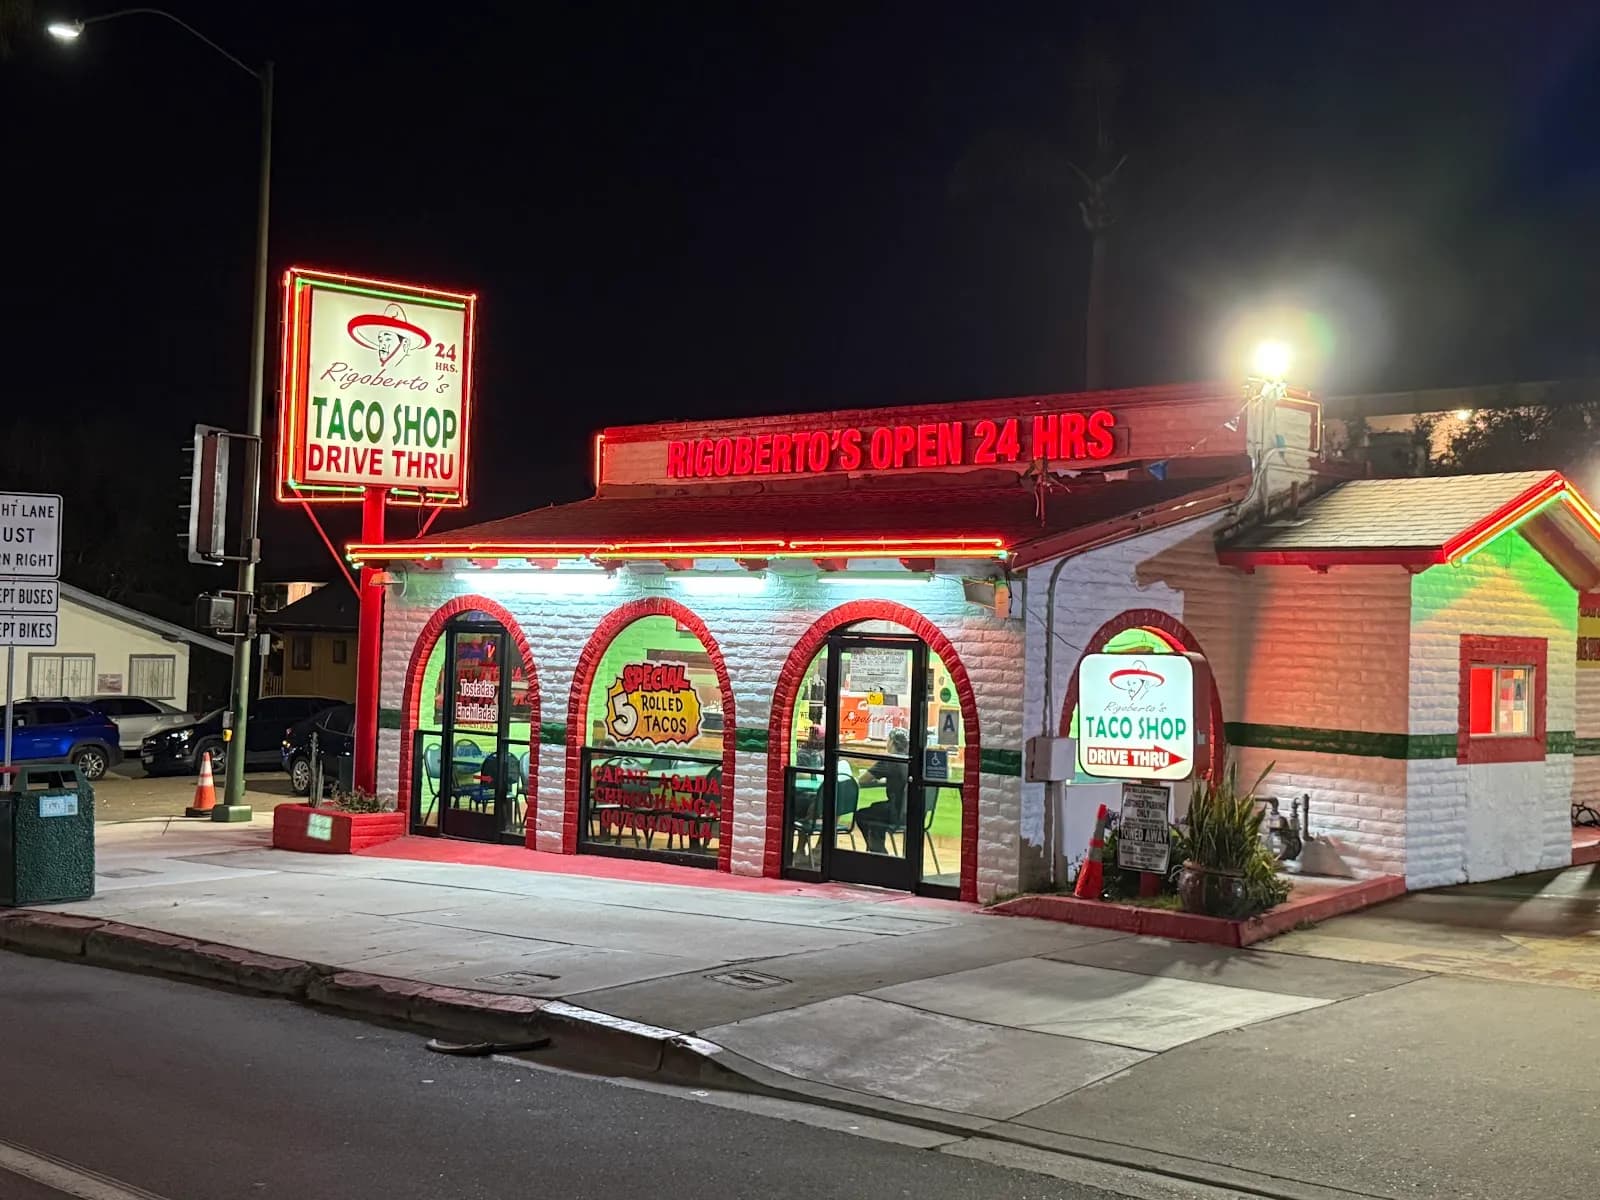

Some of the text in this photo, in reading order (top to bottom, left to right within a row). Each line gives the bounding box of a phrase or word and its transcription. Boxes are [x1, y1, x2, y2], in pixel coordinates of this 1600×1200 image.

[435, 343, 457, 362] 24
[320, 362, 450, 394] Rigoberto's
[435, 362, 459, 374] HRS.
[312, 396, 457, 449] TACO SHOP
[667, 410, 1116, 478] RIGOBERTO'S OPEN 24 HRS
[308, 443, 455, 480] DRIVE THRU
[22, 505, 55, 519] LANE
[16, 553, 54, 568] RIGHT
[19, 589, 54, 605] BUSES
[19, 623, 53, 638] BIKES
[622, 662, 691, 694] SPECIAL
[461, 679, 495, 698] Tostadas
[456, 702, 497, 722] Enchiladas
[611, 691, 684, 738] 5 ROLLED
[1104, 702, 1167, 715] Rigoberto's
[644, 715, 687, 736] TACOS
[943, 713, 956, 732] A
[1086, 716, 1187, 741] TACO SHOP
[1088, 748, 1170, 768] DRIVE THRU
[591, 765, 720, 796] CARNE ASADA
[1145, 829, 1168, 844] AWAY
